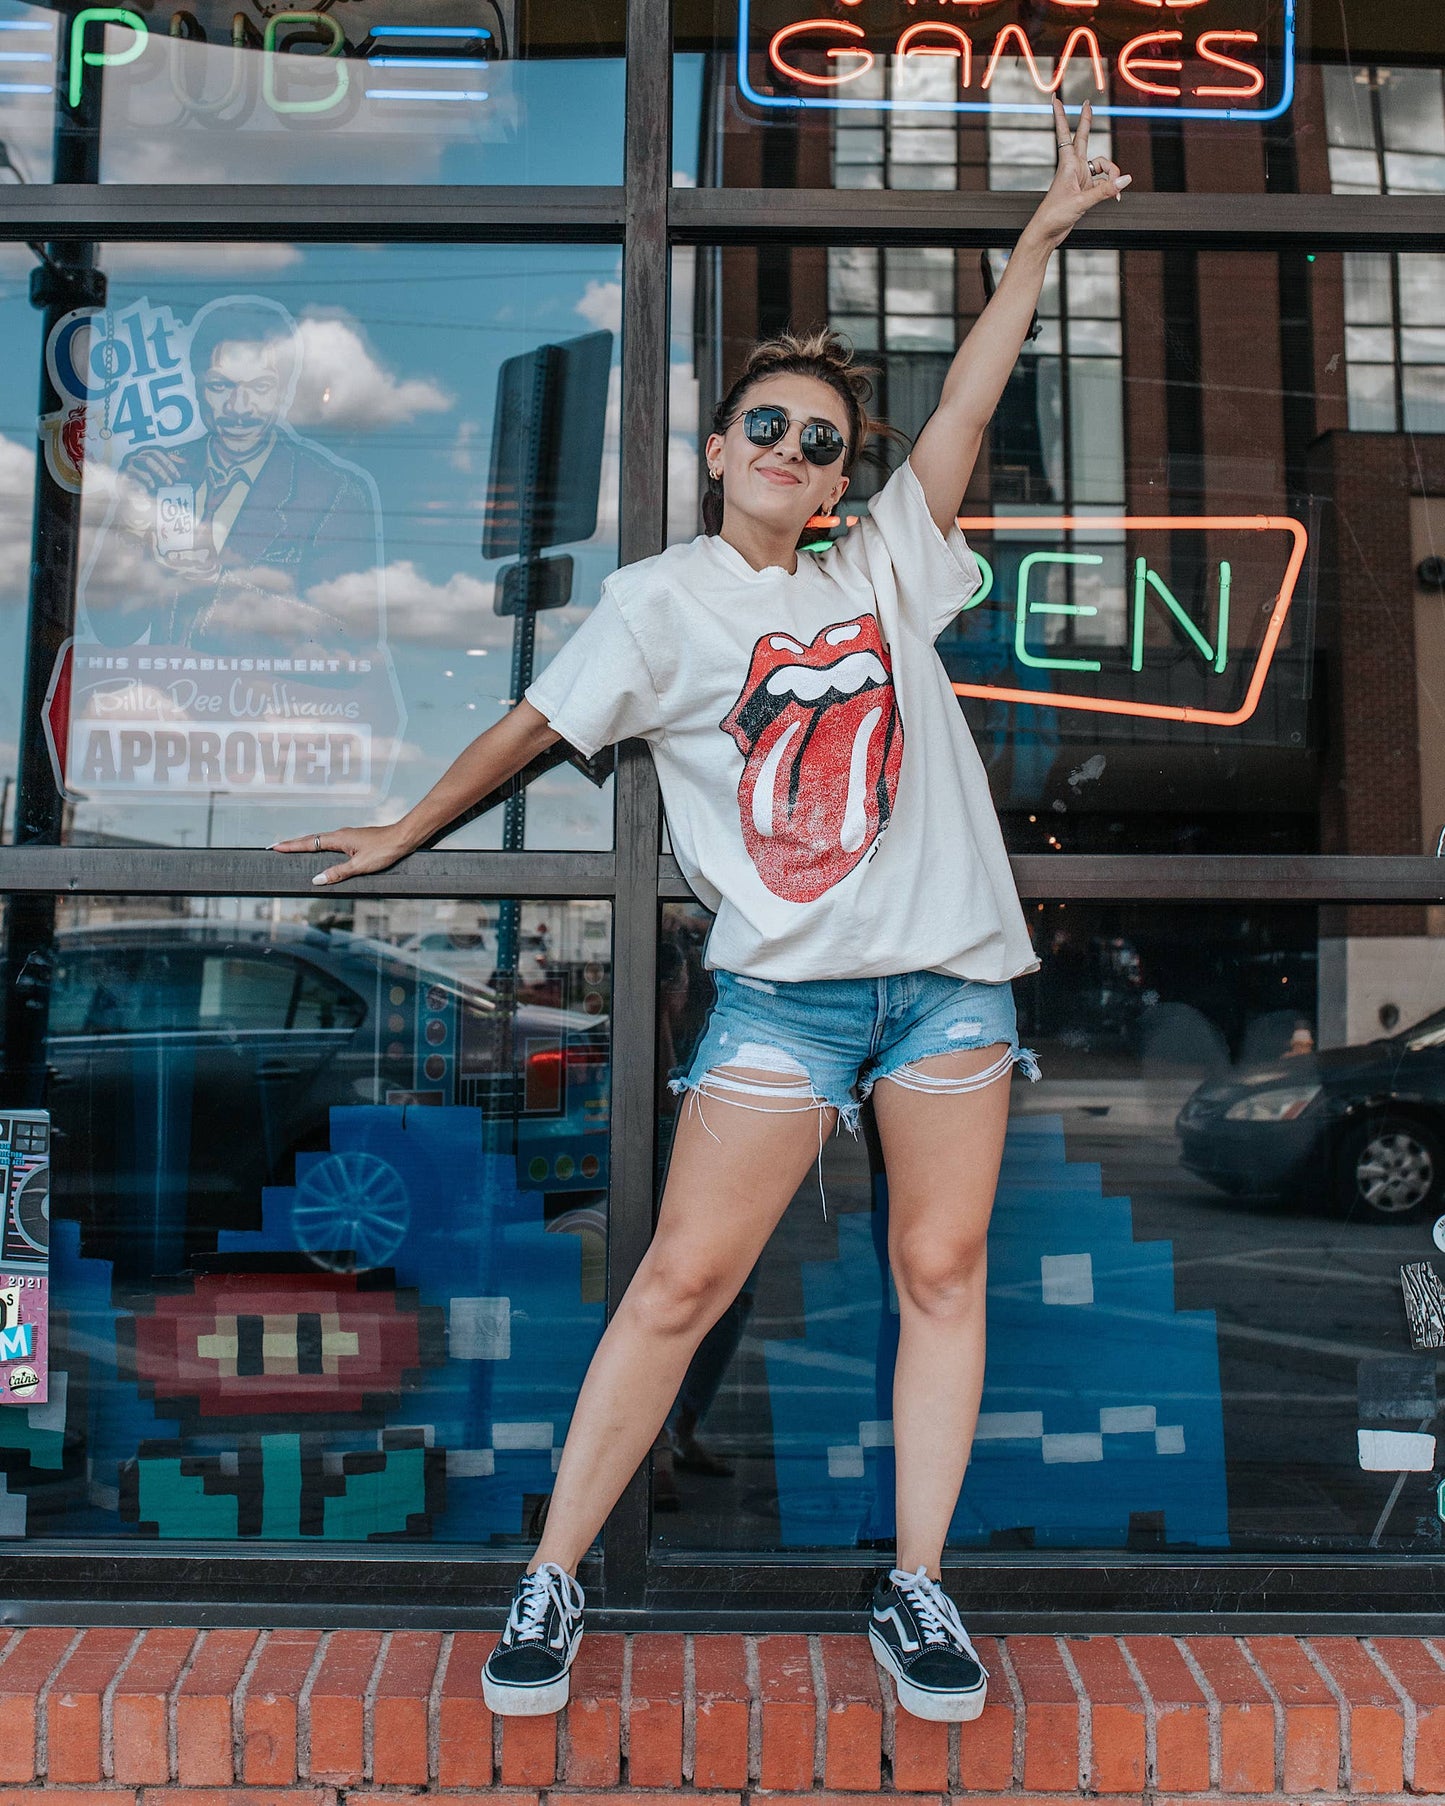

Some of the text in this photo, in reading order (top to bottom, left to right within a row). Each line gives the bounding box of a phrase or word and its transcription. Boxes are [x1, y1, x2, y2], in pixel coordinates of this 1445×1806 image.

[68, 8, 348, 113] PUB
[769, 20, 1265, 97] GAMES
[54, 311, 181, 401] Colt
[112, 373, 194, 444] 45
[161, 496, 189, 522] Colt
[74, 657, 372, 673] THIS ESTABLISHMENT IS
[80, 677, 360, 721] Billy Dee Williams
[82, 730, 362, 784] APPROVED
[9, 1276, 42, 1289] 2021
